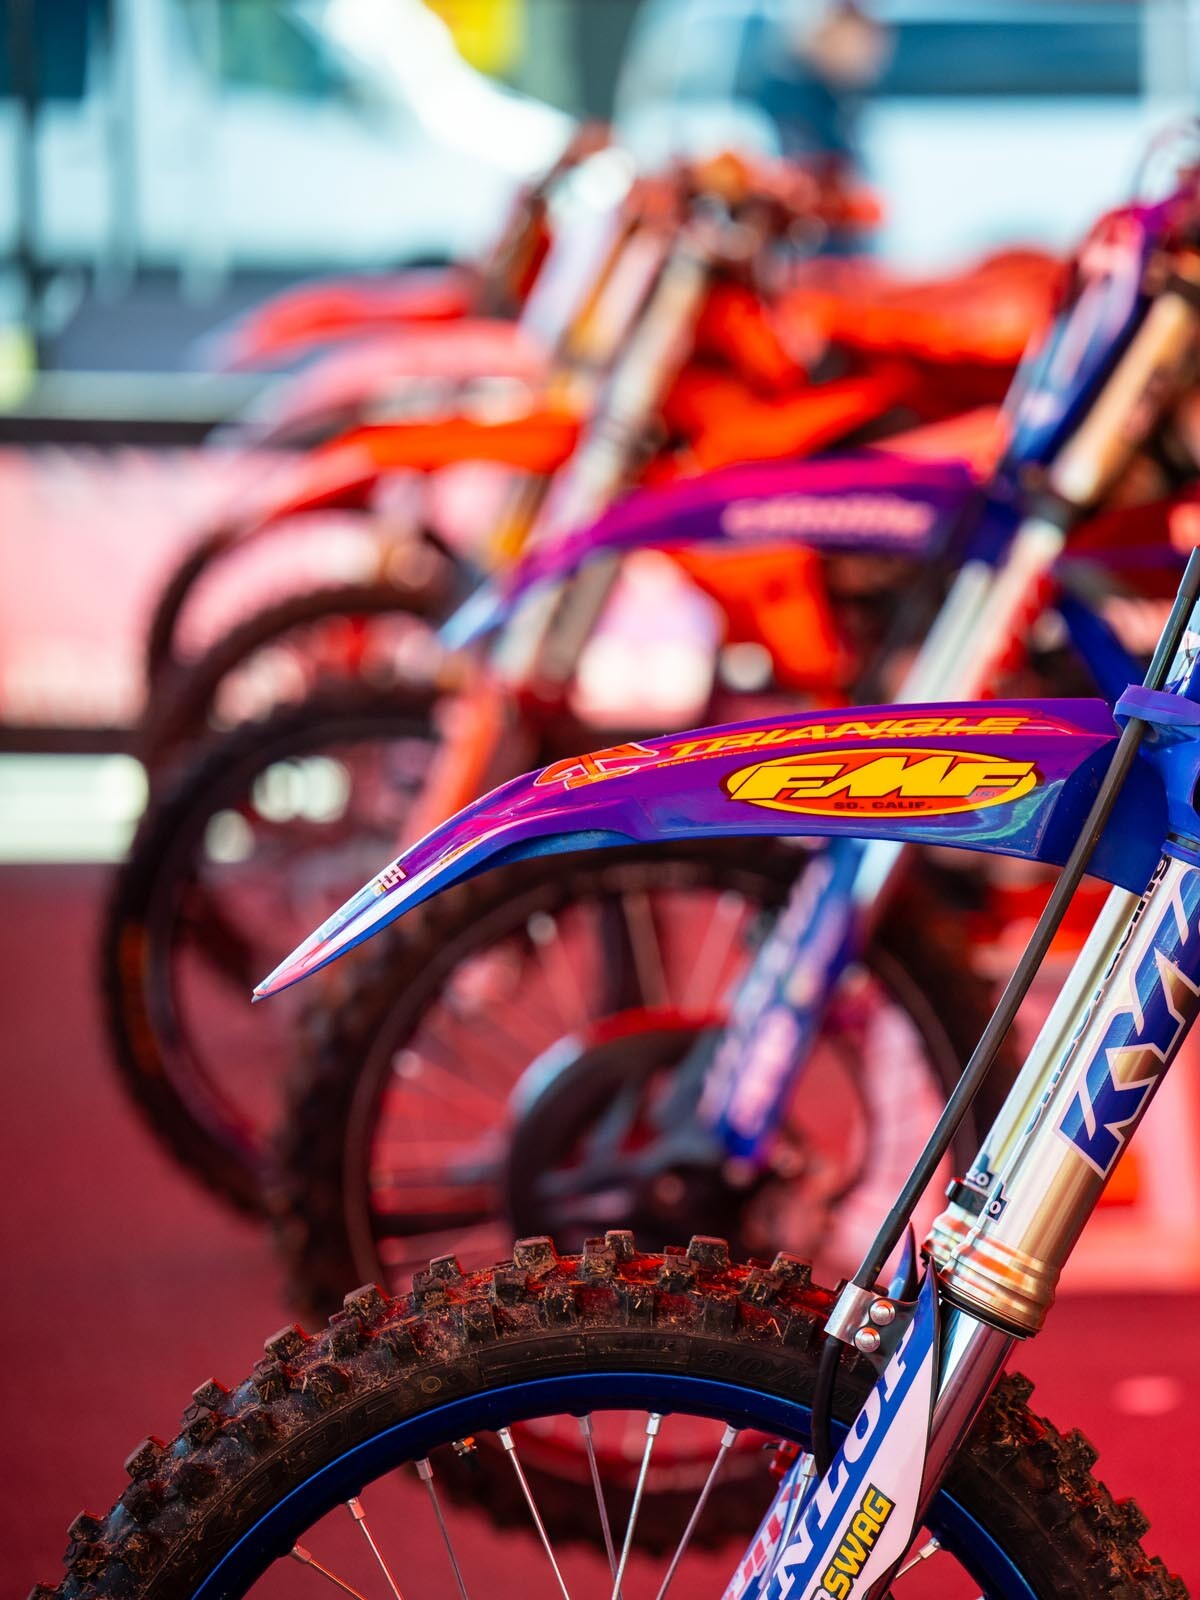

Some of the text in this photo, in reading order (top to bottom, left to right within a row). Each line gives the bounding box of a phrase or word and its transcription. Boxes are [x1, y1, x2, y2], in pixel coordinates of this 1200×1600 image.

[670, 716, 1030, 758] TRIANGLE
[730, 756, 1036, 801] FMF
[833, 801, 933, 810] SO. CALIF.
[762, 1318, 914, 1600] NLOP
